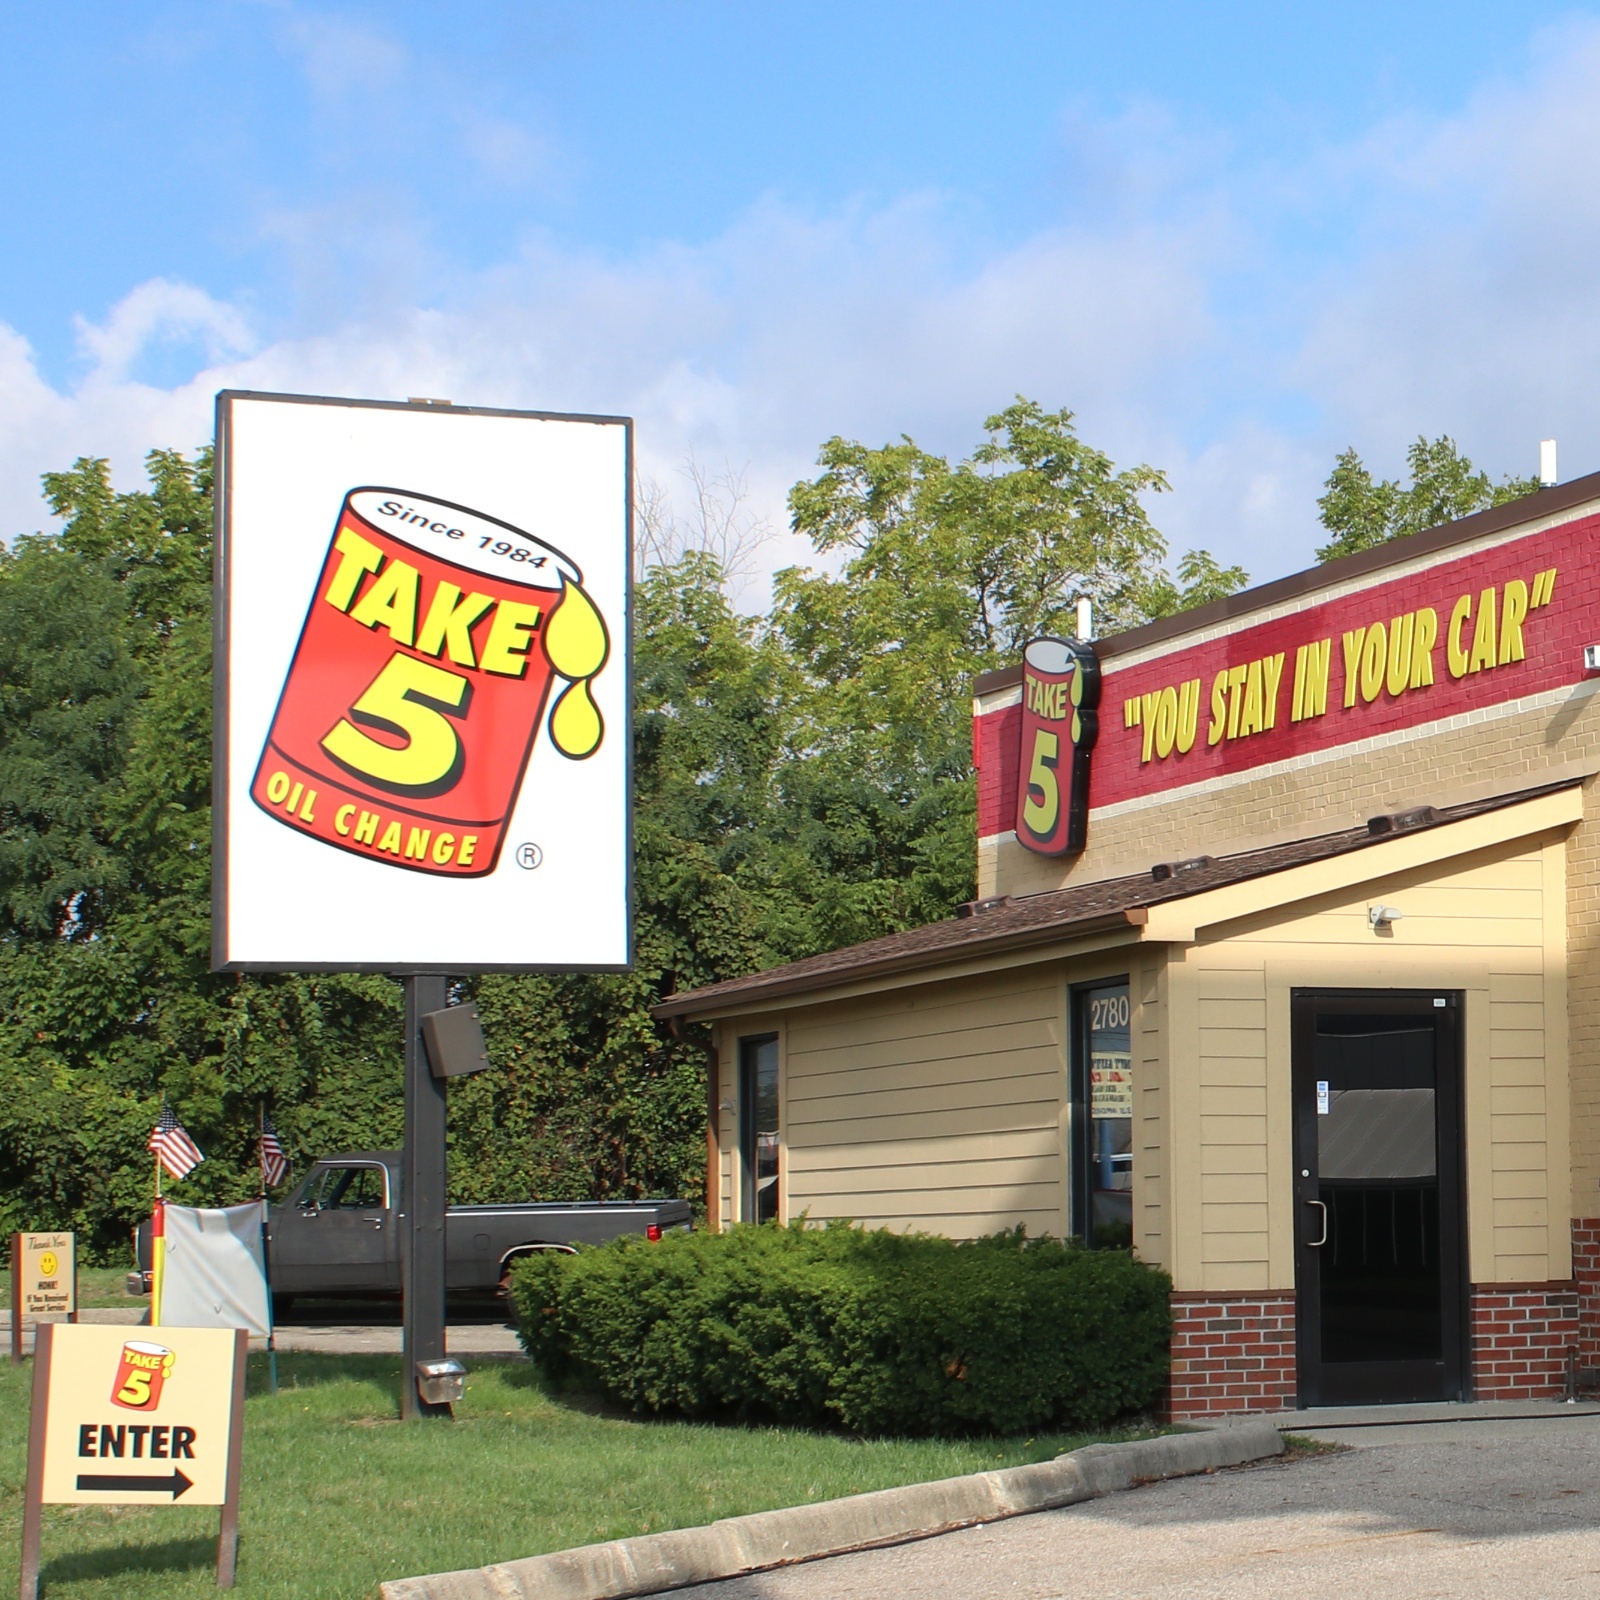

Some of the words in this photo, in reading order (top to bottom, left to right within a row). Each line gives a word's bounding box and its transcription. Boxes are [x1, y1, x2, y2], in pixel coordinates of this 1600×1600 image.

[376, 501, 465, 541] Since
[478, 534, 549, 569] 1984
[324, 525, 543, 680] TAKE
[1025, 673, 1068, 720] TAKE
[1208, 652, 1285, 747] STAY
[1291, 638, 1331, 723] IN
[1342, 606, 1438, 708] YOUR
[320, 651, 473, 797] 5
[1023, 729, 1060, 842] 5
[266, 771, 316, 824] OIL
[334, 803, 479, 868] CHANGE
[1092, 996, 1129, 1030] 2780
[28, 1237, 51, 1249] Thank
[53, 1235, 67, 1247] You
[33, 1294, 43, 1302] You
[124, 1349, 161, 1369] TAKE
[117, 1369, 152, 1406] 5
[79, 1424, 197, 1459] ENTER
